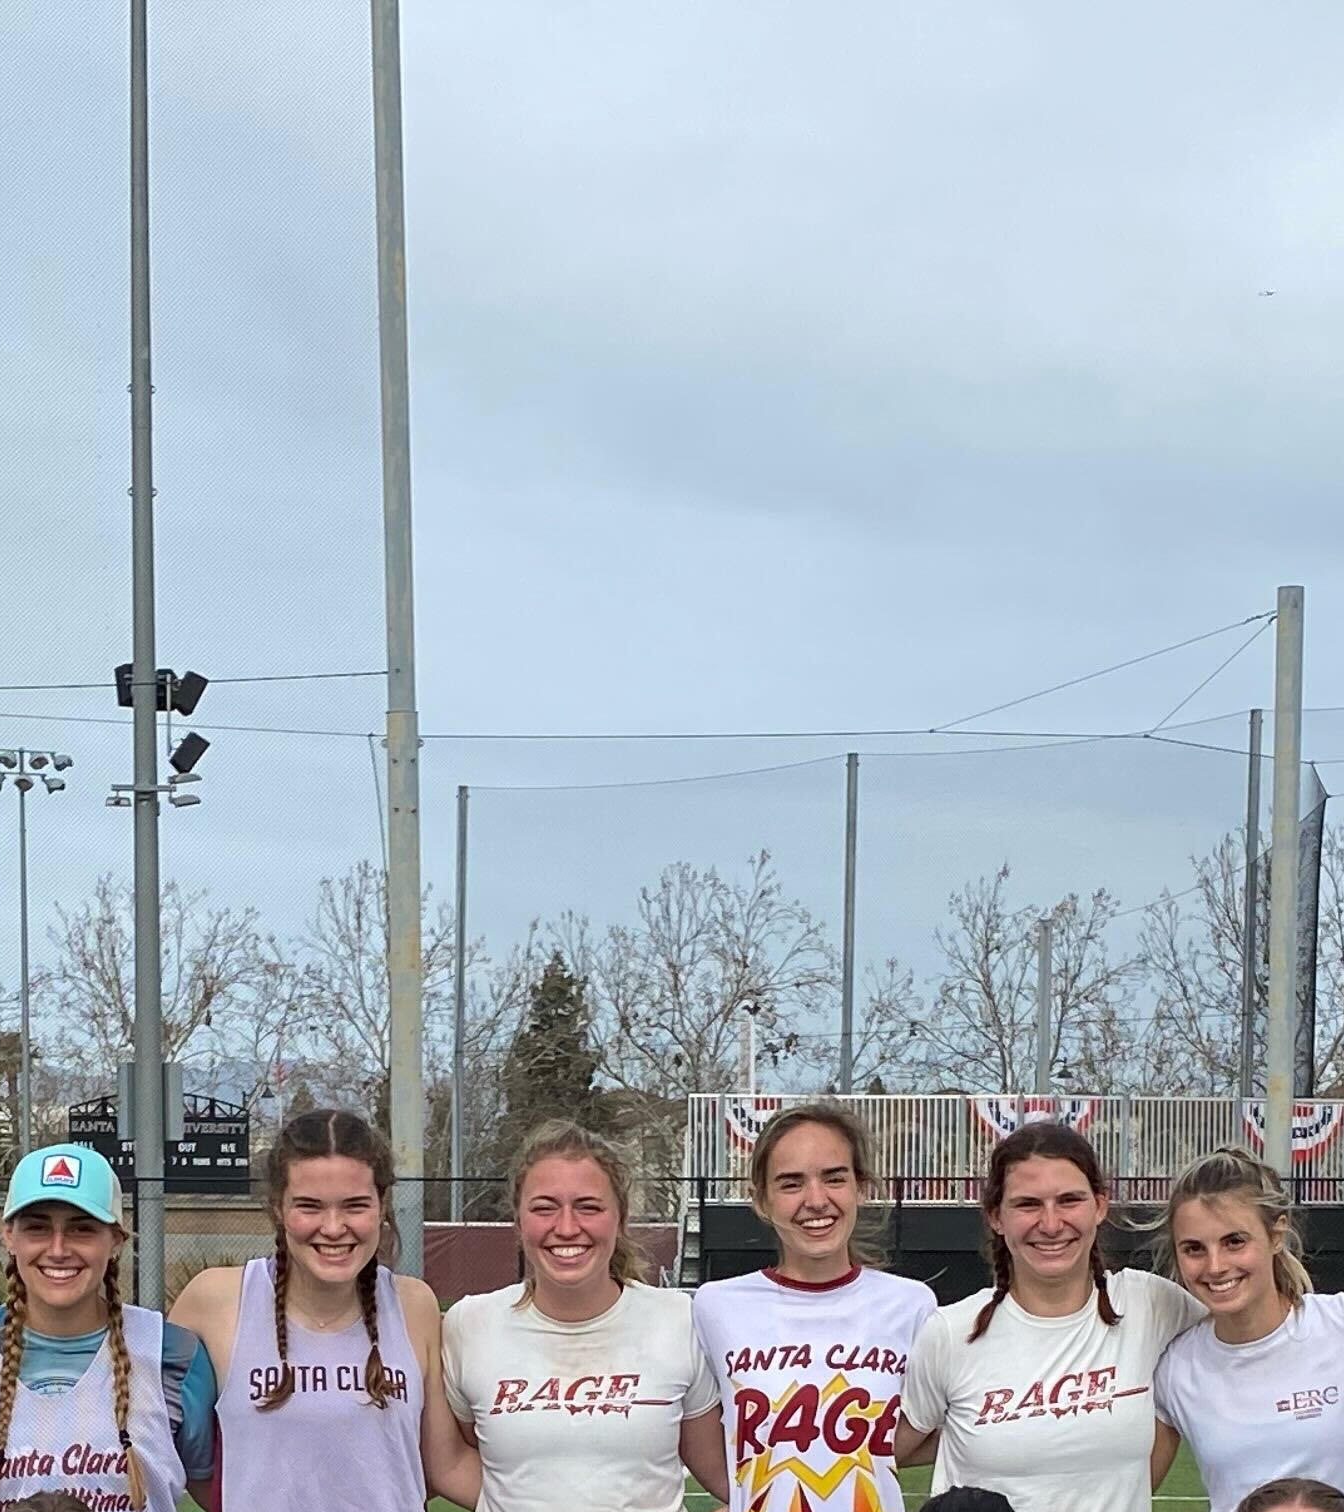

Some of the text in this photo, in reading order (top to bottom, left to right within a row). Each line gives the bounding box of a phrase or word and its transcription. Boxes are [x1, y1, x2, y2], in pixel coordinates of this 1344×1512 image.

[184, 1122, 247, 1134] IVERSITY
[725, 1344, 812, 1378] SANTA
[490, 1373, 640, 1420] RAGE
[974, 1366, 1116, 1426] RAGE
[734, 1384, 901, 1463] RAGE
